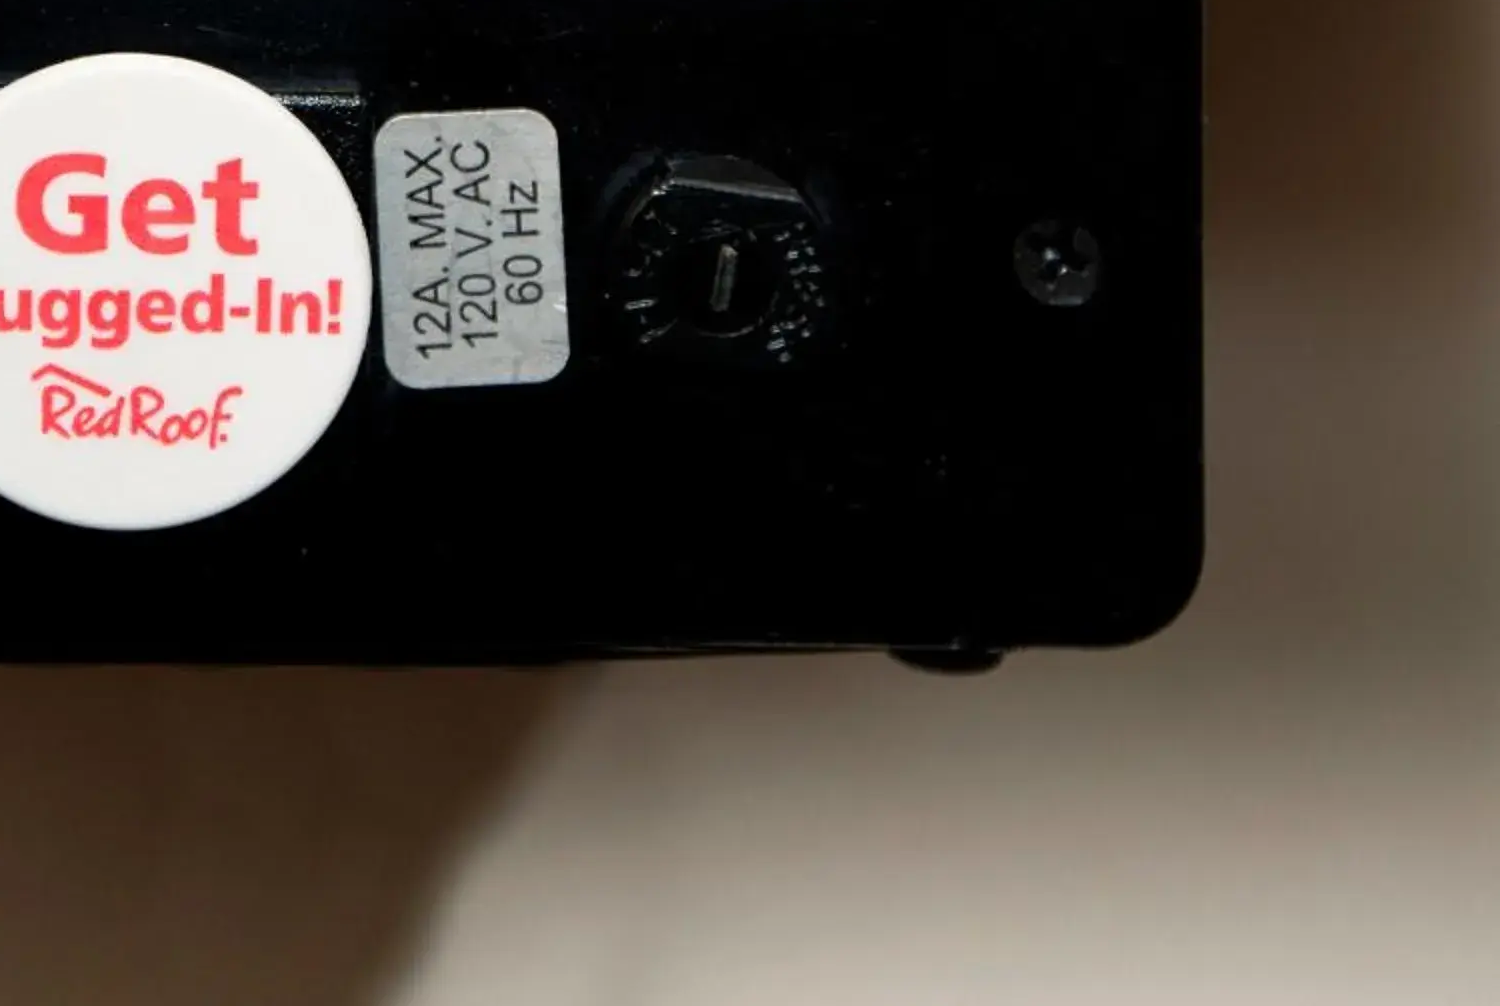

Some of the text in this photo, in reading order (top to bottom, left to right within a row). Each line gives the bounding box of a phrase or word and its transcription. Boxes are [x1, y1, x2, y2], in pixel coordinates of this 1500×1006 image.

[14, 151, 260, 257] Get
[403, 136, 453, 360] 12A. MAX.
[500, 180, 544, 306] 60 Hz
[457, 273, 498, 348] 120
